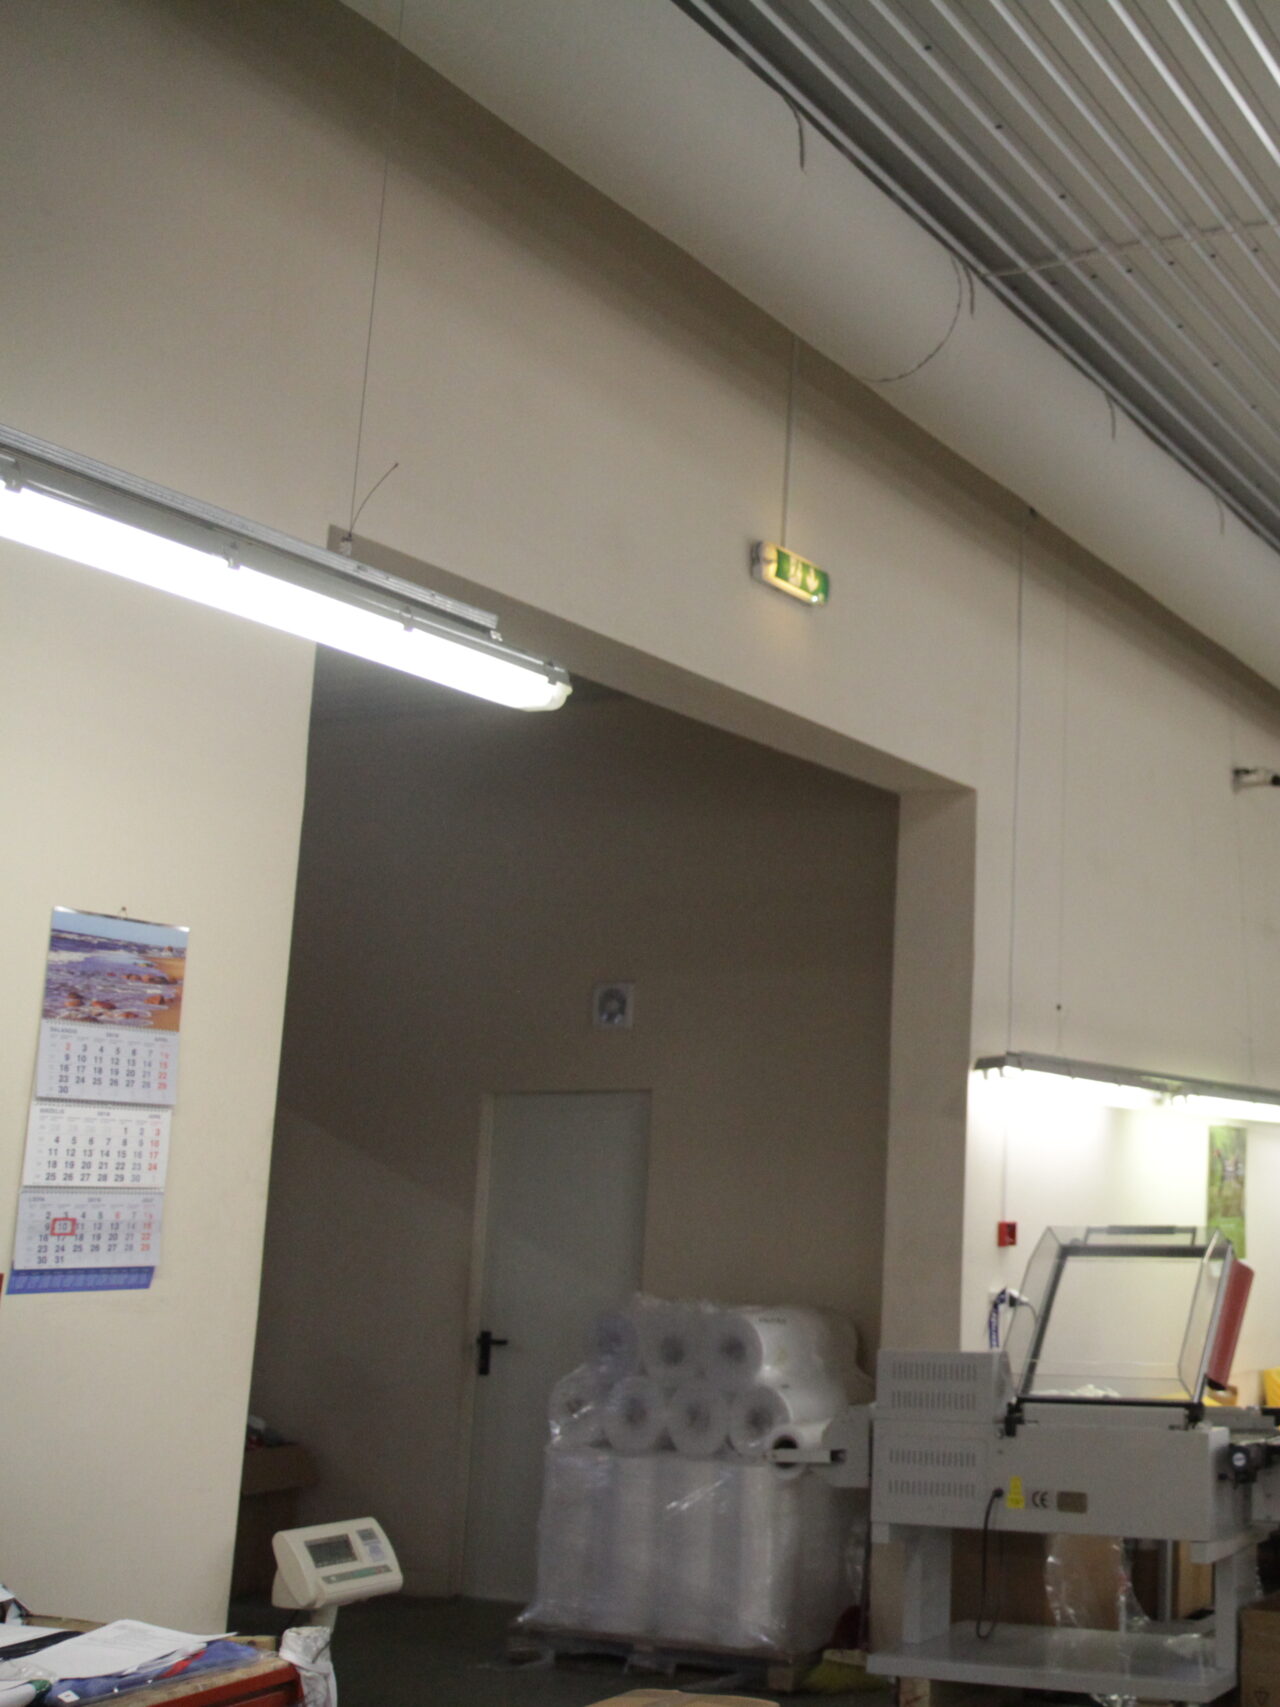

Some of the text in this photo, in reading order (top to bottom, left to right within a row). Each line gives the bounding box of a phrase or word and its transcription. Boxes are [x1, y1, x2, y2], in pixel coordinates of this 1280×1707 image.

[99, 1045, 104, 1053] 4
[78, 1055, 86, 1063] 10
[111, 1057, 120, 1065] 12
[77, 1065, 86, 1073] 17
[126, 1069, 135, 1077] 20
[59, 1075, 68, 1083] 23
[75, 1076, 85, 1084] 24
[93, 1077, 102, 1085] 25
[126, 1079, 135, 1087] 27
[58, 1085, 68, 1093] 30
[54, 1136, 60, 1144] 4
[48, 1148, 58, 1156] 11
[66, 1149, 76, 1157] 12
[100, 1150, 110, 1158] 14
[48, 1160, 57, 1168] 18
[81, 1161, 91, 1169] 20
[98, 1162, 108, 1170] 21
[115, 1162, 125, 1170] 22
[45, 1173, 56, 1181] 25
[63, 1173, 73, 1181] 26
[80, 1173, 91, 1181] 27
[114, 1174, 124, 1182] 29
[108, 1233, 118, 1241] 20
[37, 1245, 47, 1253] 23
[55, 1244, 65, 1253] 24
[73, 1244, 83, 1252] 25
[90, 1244, 100, 1252] 26
[107, 1244, 117, 1252] 27
[37, 1256, 47, 1264] 30
[1032, 1491, 1048, 1508] CE
